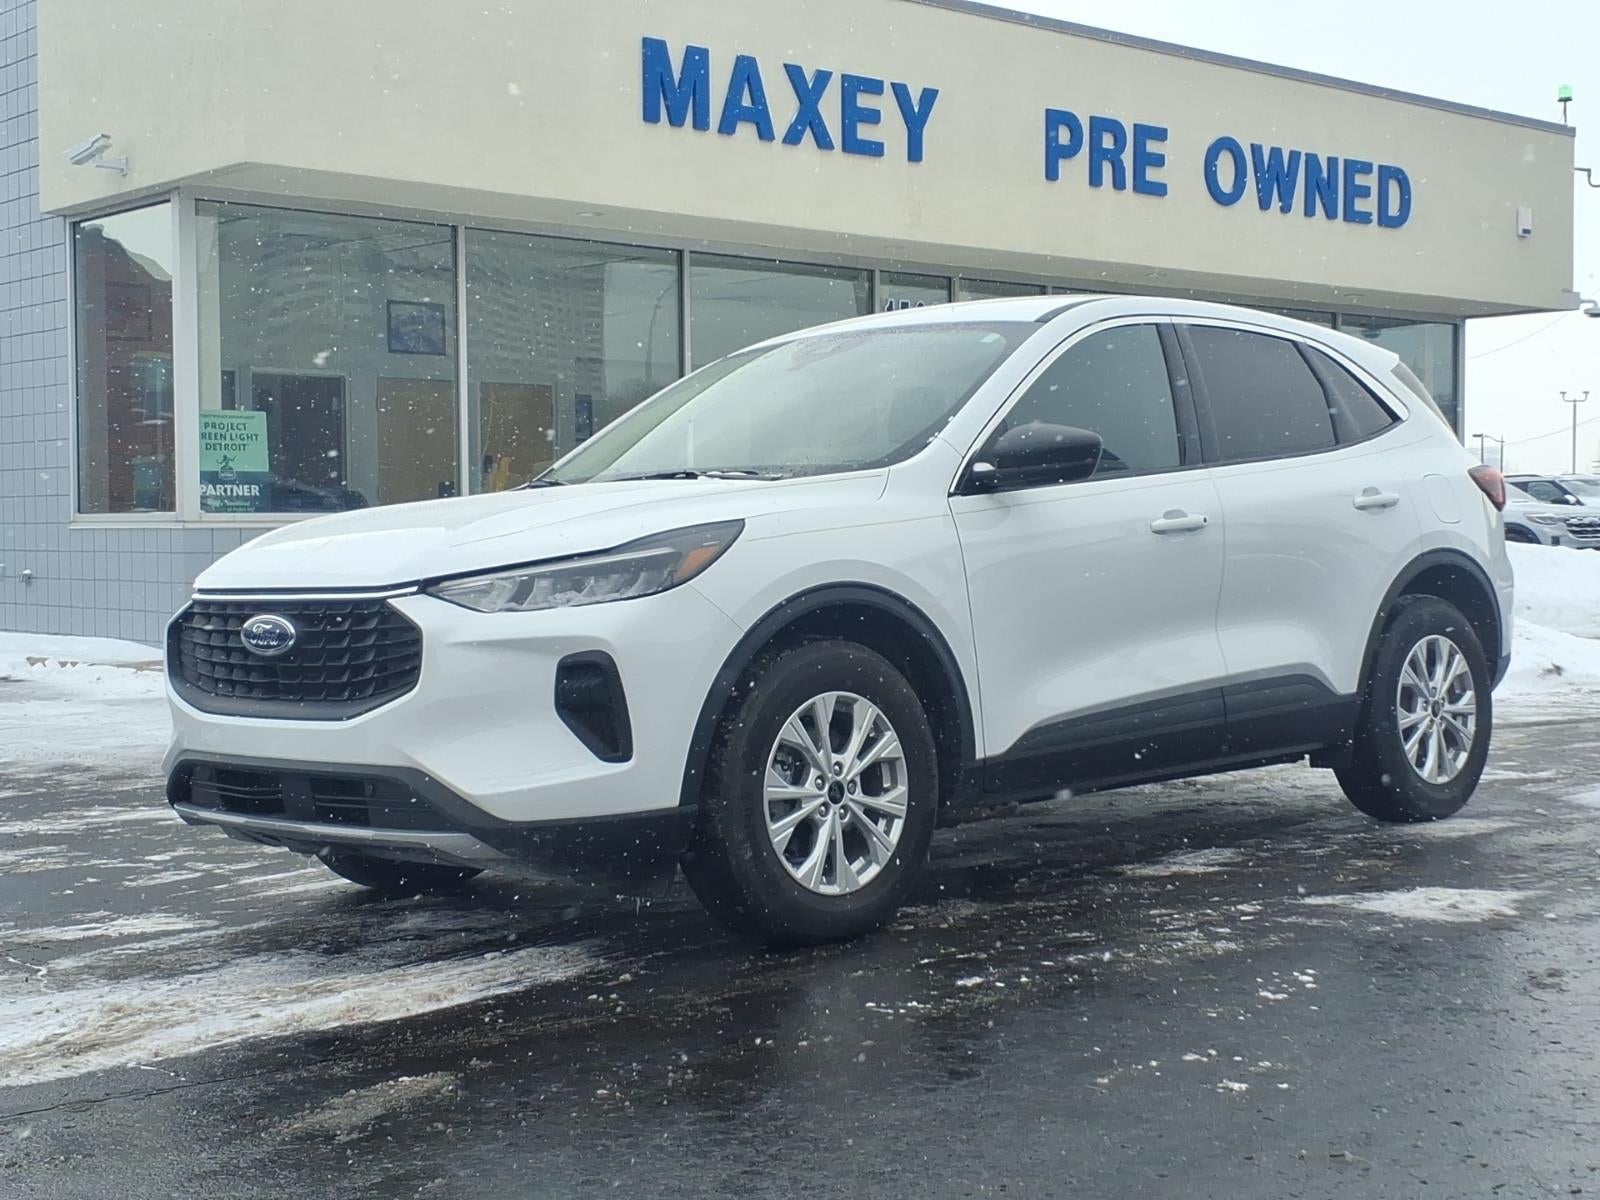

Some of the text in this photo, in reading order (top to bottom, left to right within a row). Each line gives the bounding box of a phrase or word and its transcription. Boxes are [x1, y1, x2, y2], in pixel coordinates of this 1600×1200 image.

[641, 37, 1413, 229] MAXEY PRE OWNED
[203, 421, 248, 433] PROJECT
[200, 431, 260, 442] REEN LIGHT
[204, 442, 247, 452] DETROIT
[199, 483, 261, 497] PARTNER
[248, 623, 280, 646] Ford
